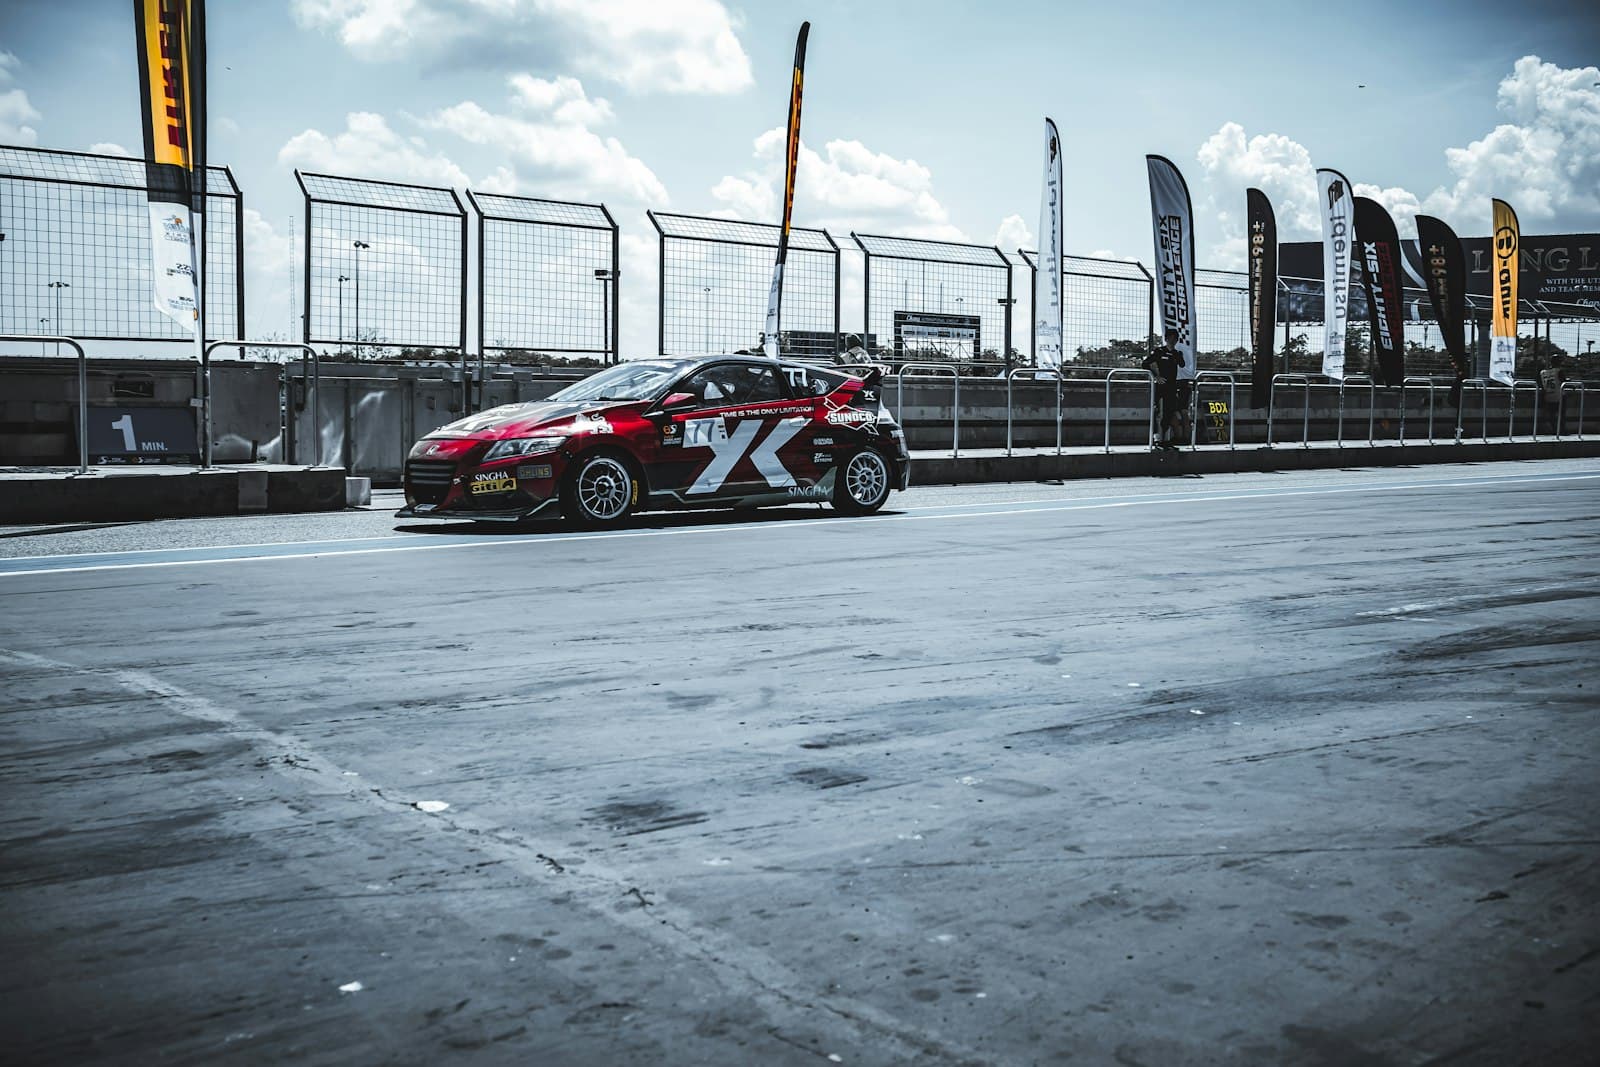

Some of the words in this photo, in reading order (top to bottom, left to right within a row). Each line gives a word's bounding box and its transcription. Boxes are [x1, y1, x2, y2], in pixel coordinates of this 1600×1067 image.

[1169, 216, 1188, 321] CHALLENGE
[1471, 247, 1570, 273] LNG
[1363, 242, 1393, 351] EIGHTY-SIX
[782, 368, 808, 387] 77
[720, 410, 737, 418] TIME
[746, 408, 760, 416] THE
[761, 407, 779, 415] ONLY
[780, 406, 814, 414] LIMITATION
[830, 411, 874, 423] SUNOCO
[1208, 402, 1228, 414] BOX
[111, 414, 137, 451] 1
[141, 441, 168, 451] MIN.
[692, 419, 715, 444] 77
[475, 471, 509, 482] SINGHA
[788, 485, 828, 497] SINGHA
